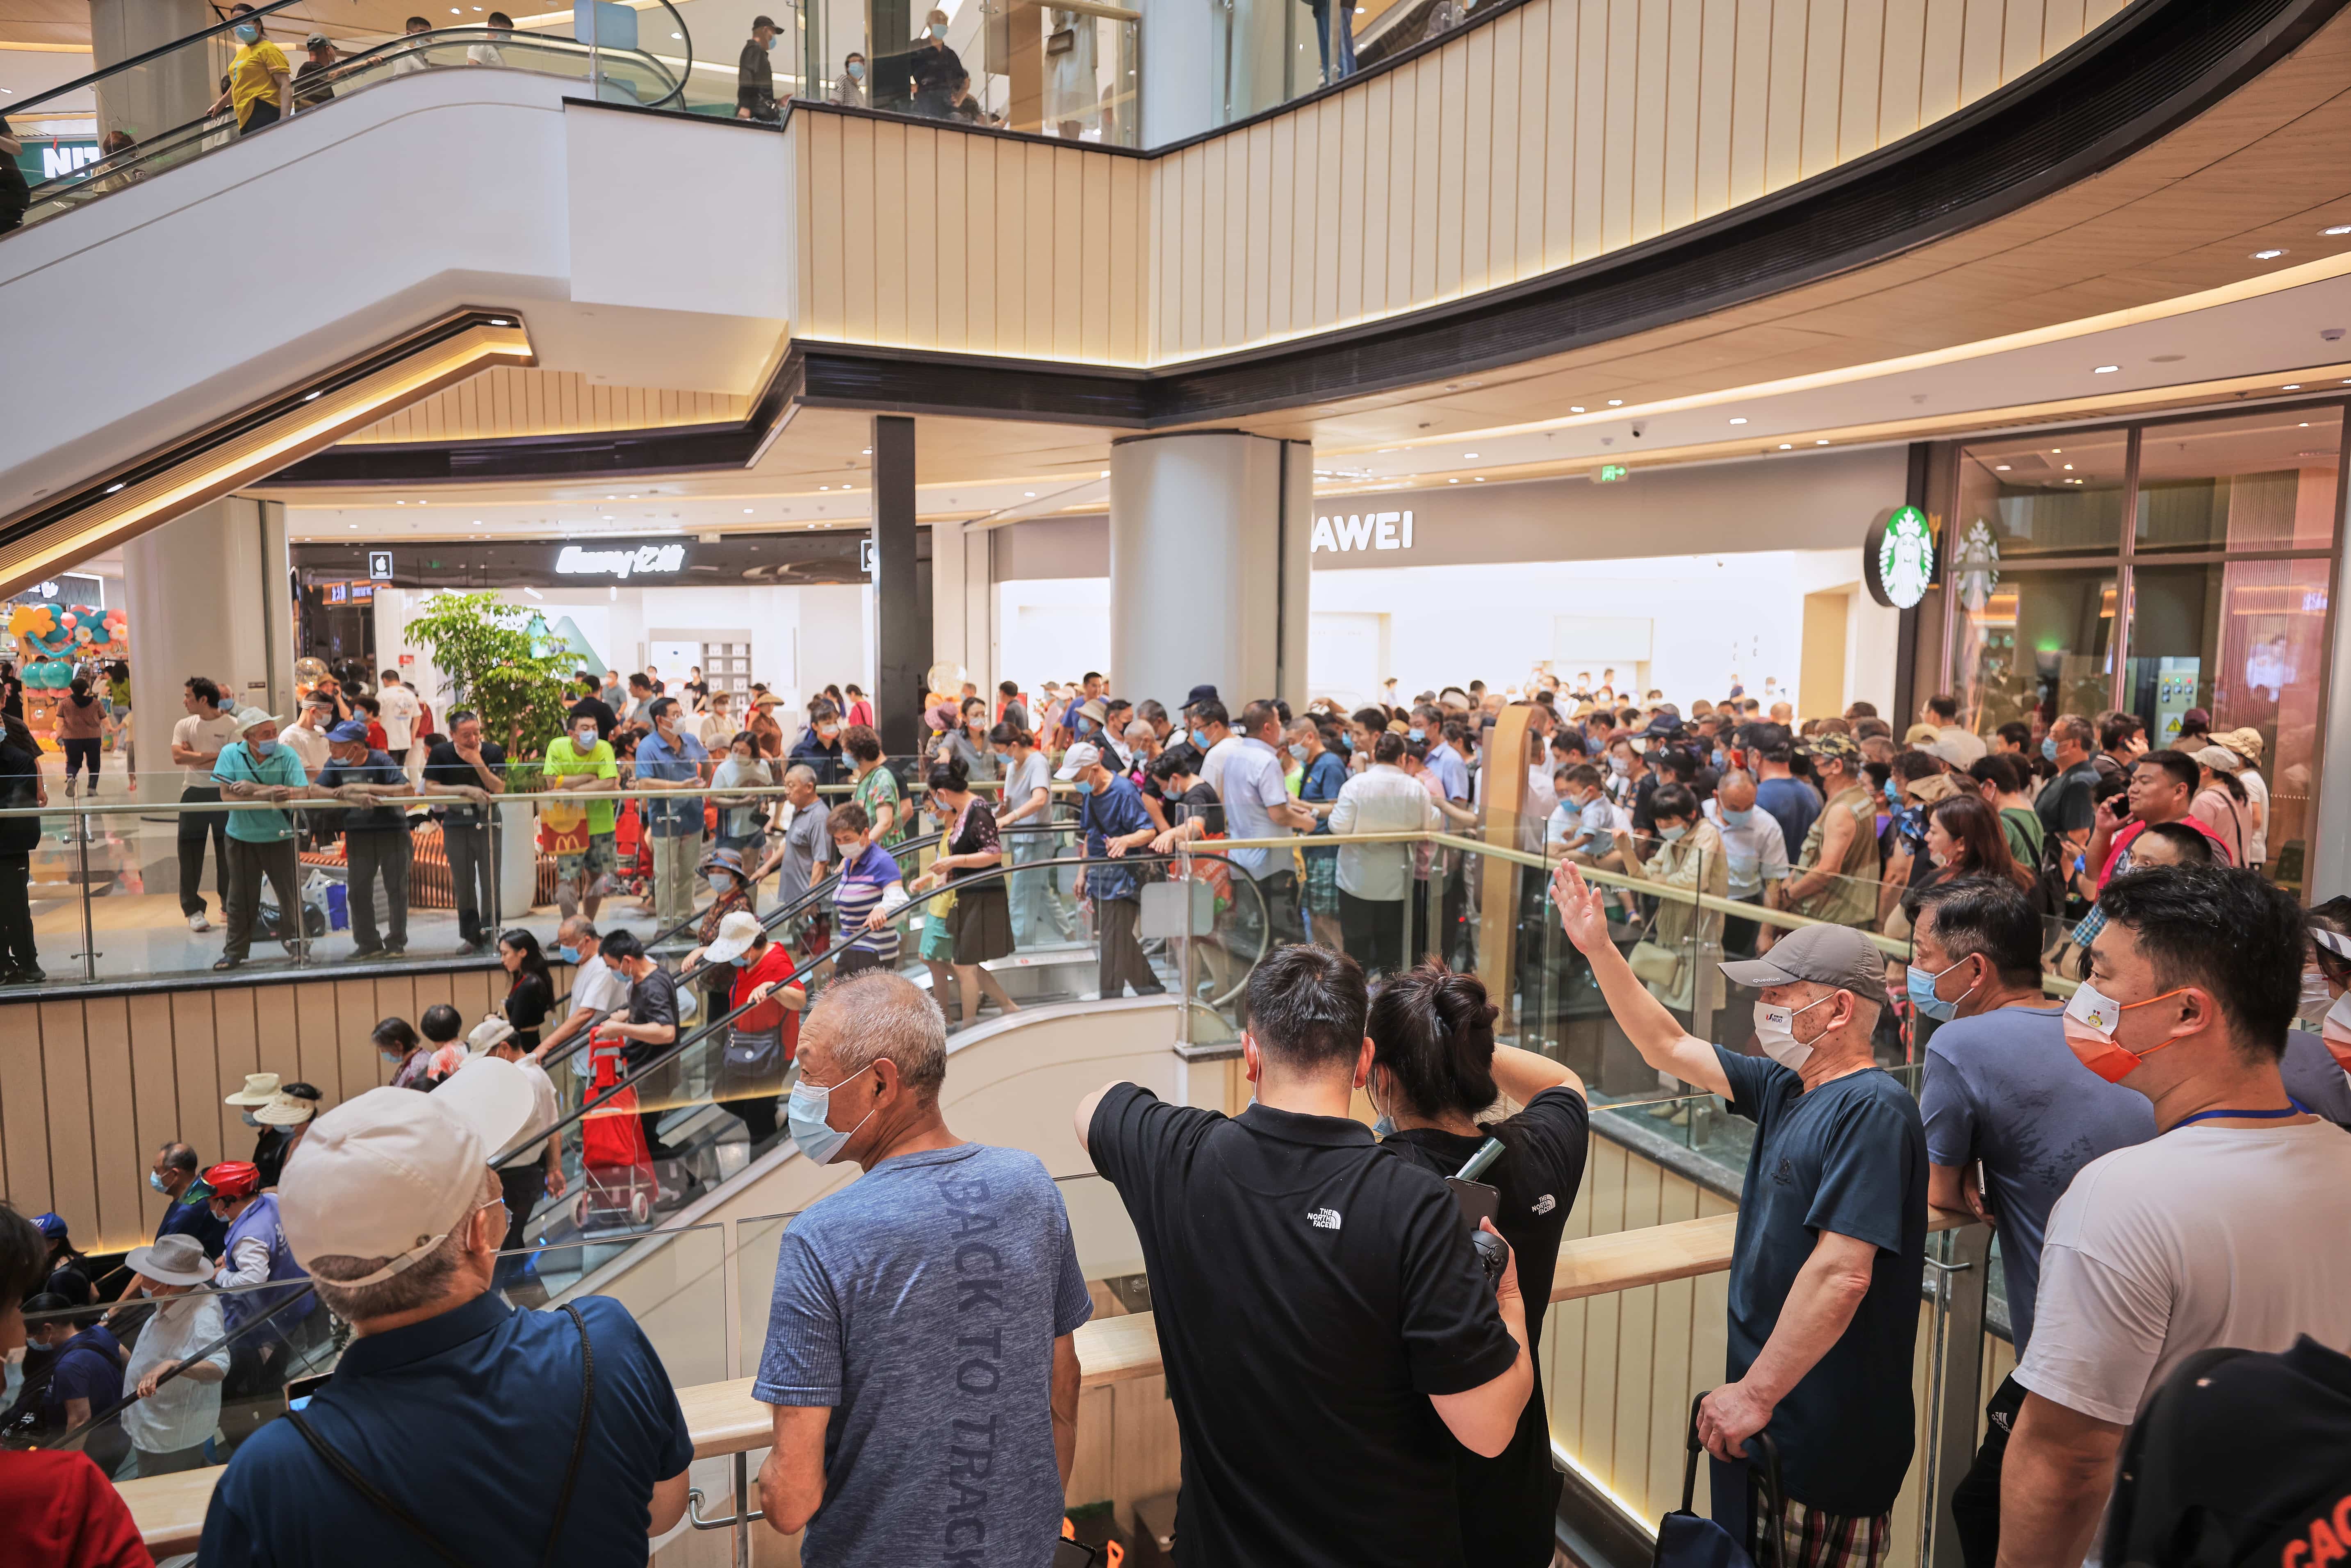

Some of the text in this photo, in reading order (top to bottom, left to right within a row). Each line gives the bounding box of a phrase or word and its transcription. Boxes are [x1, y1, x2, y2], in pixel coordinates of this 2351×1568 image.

[1310, 510, 1413, 553] AWEI
[1531, 1198, 1549, 1212] NORTH
[1539, 1195, 1547, 1203] THE
[1307, 1212, 1331, 1222] NORTH
[1538, 1205, 1549, 1215] FACE
[936, 1178, 1004, 1314] BACK
[956, 1327, 1002, 1395] TO
